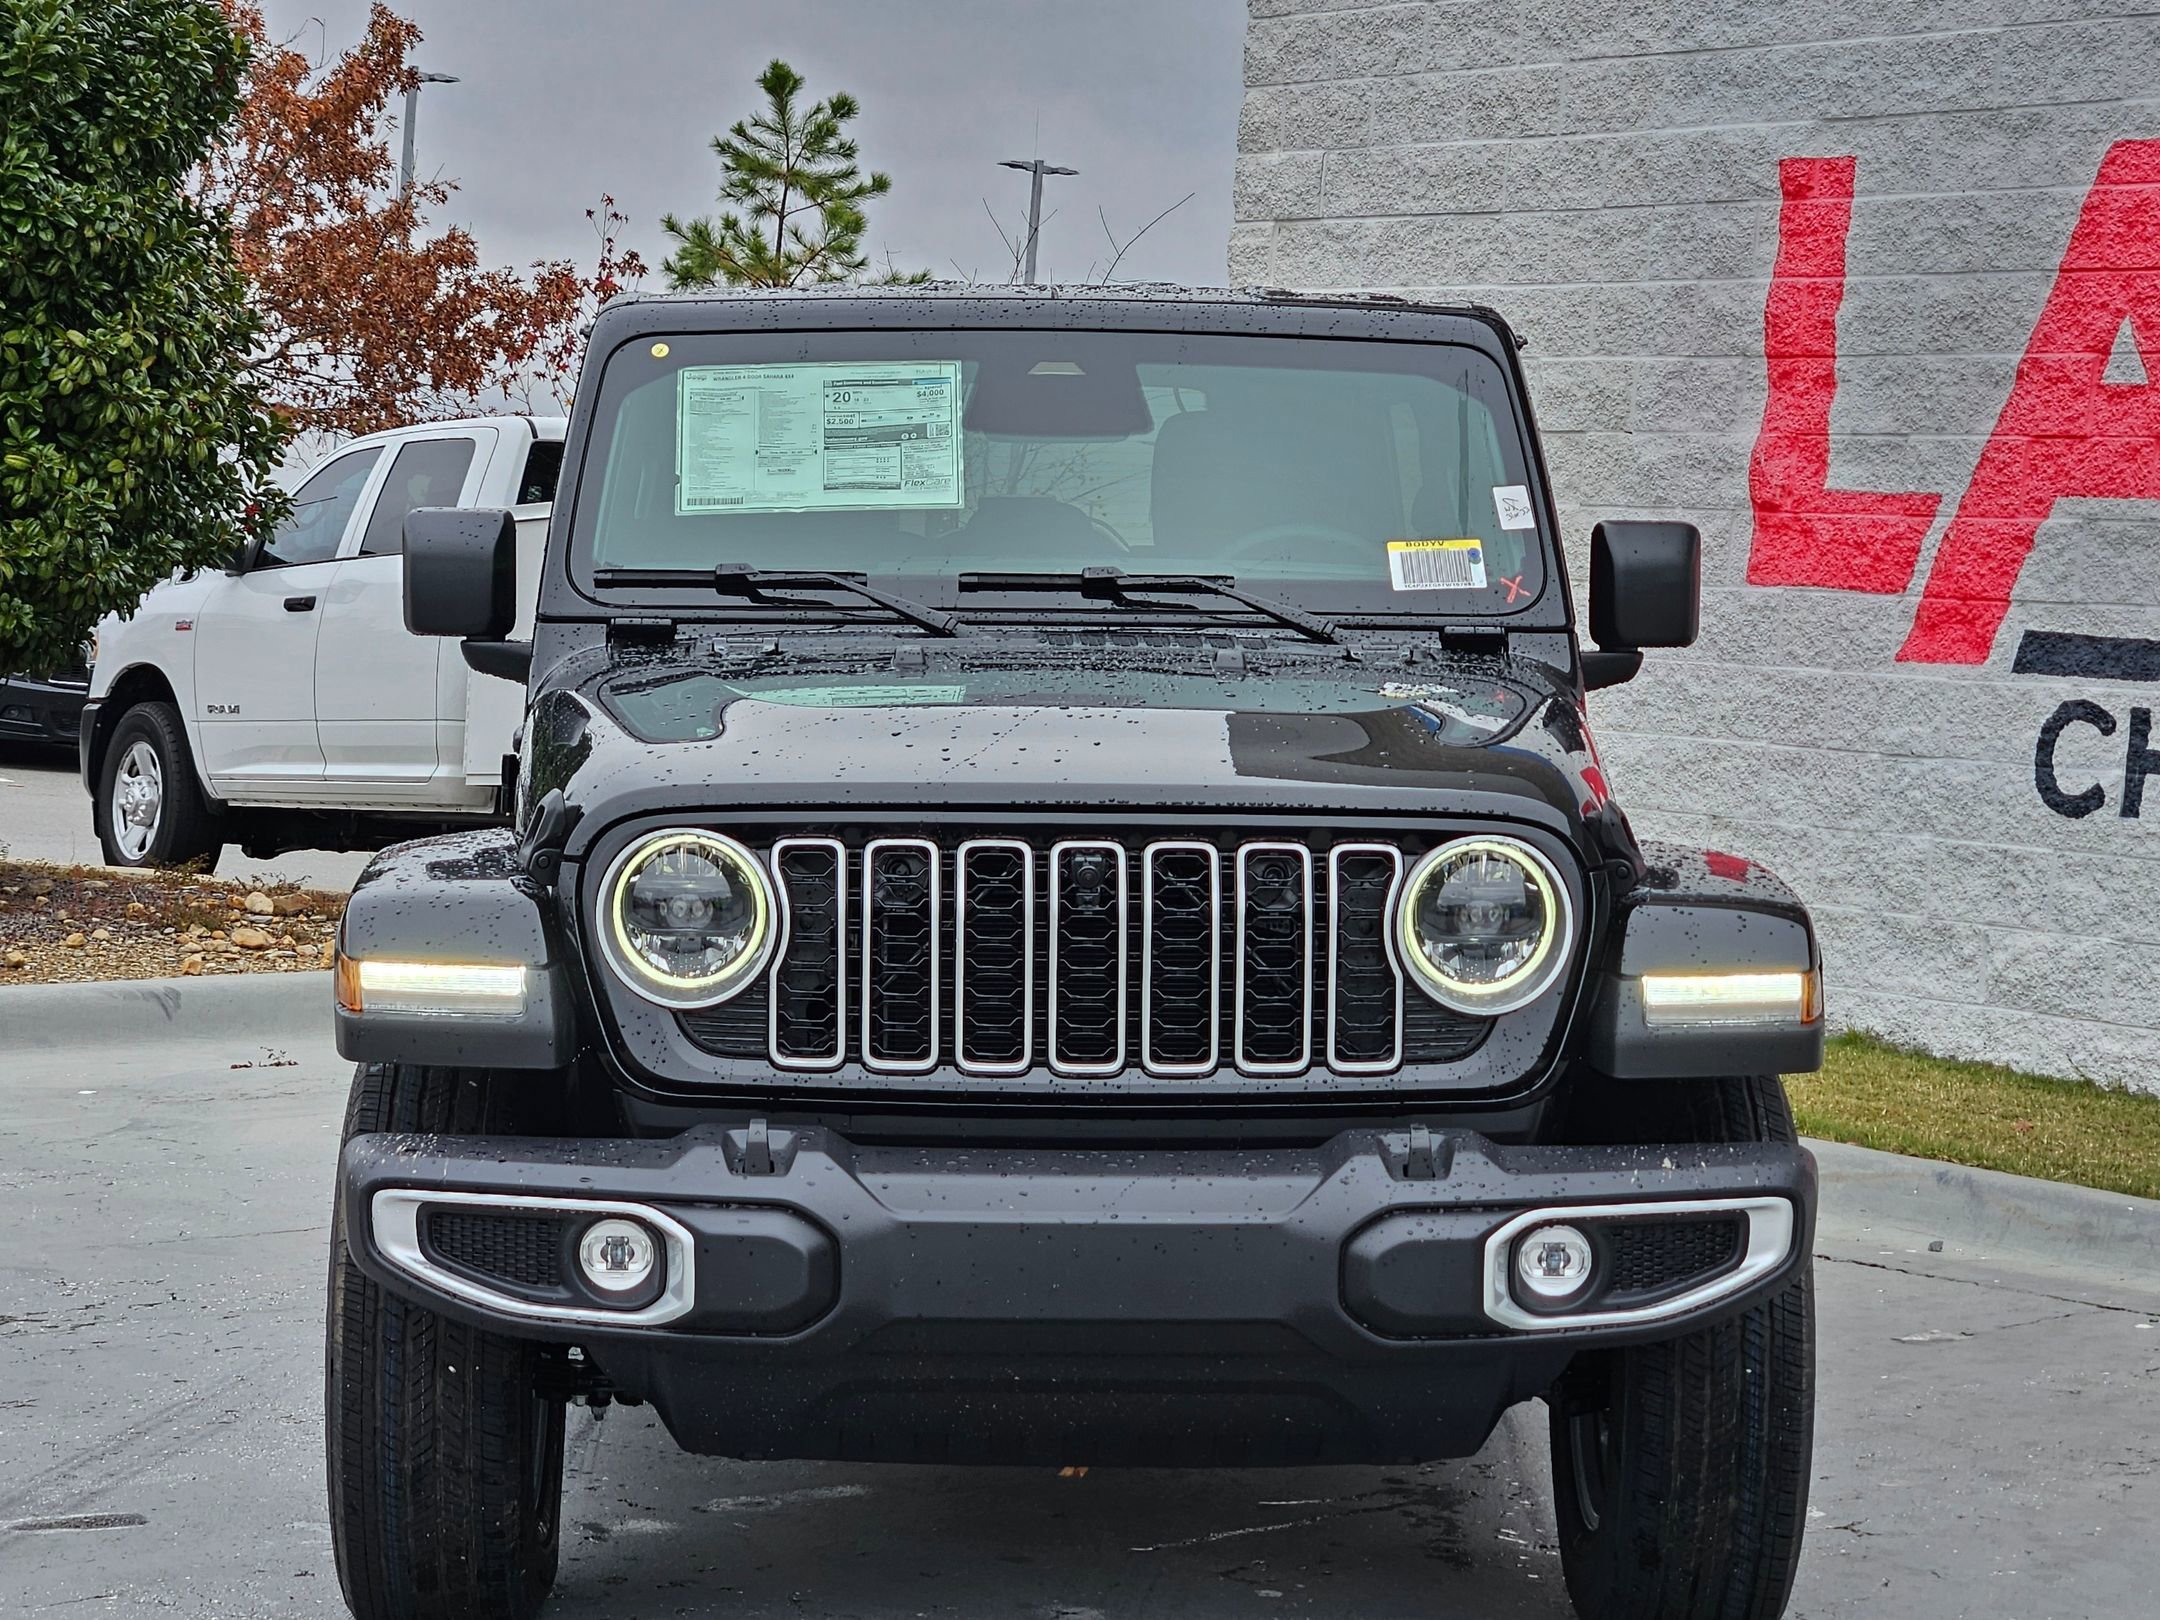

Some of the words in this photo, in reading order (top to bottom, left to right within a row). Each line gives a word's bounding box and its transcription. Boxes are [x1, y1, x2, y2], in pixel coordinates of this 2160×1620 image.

[713, 374, 742, 382] WRANGLER
[832, 391, 851, 403] 20
[916, 388, 944, 398] $4,000
[904, 478, 952, 487] FlexCare
[207, 704, 240, 714] RAM
